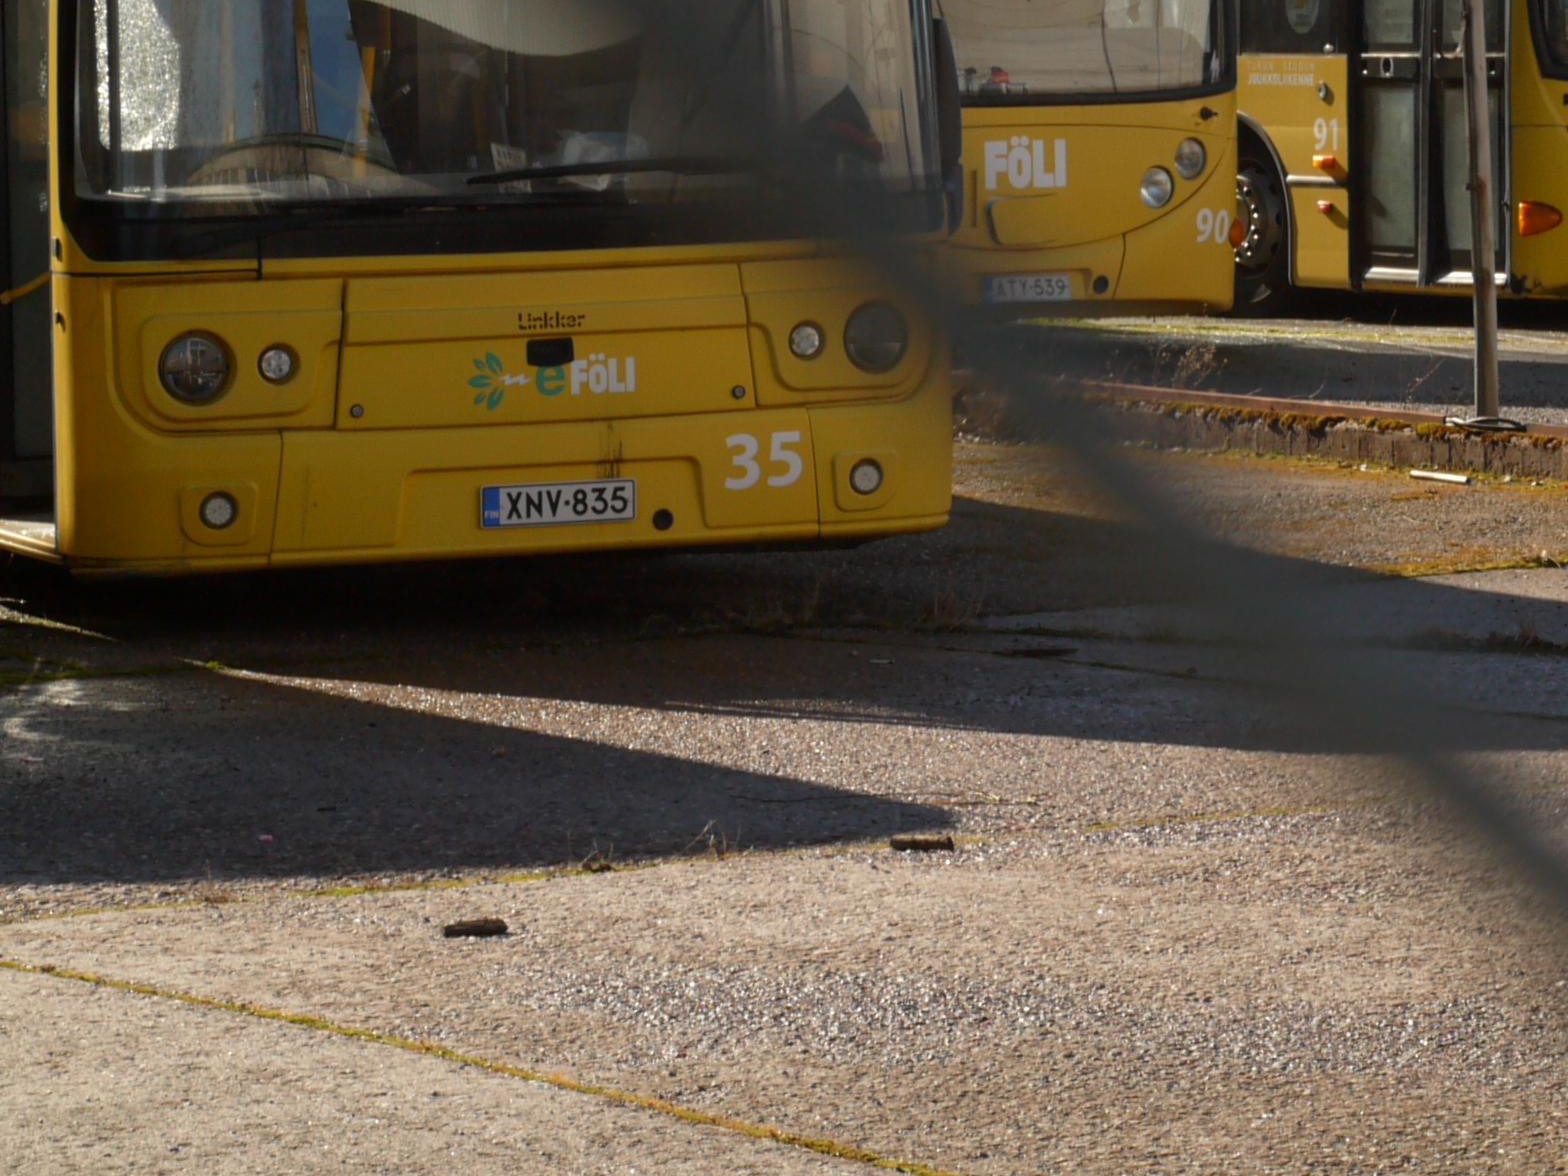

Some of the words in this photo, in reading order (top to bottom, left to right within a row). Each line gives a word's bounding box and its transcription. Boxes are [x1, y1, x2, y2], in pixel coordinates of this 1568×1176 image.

[1313, 117, 1339, 151] 91
[984, 135, 1067, 190] FÖLI
[1196, 208, 1229, 244] 90
[724, 430, 803, 491] 35
[506, 485, 629, 521] XNV-835
